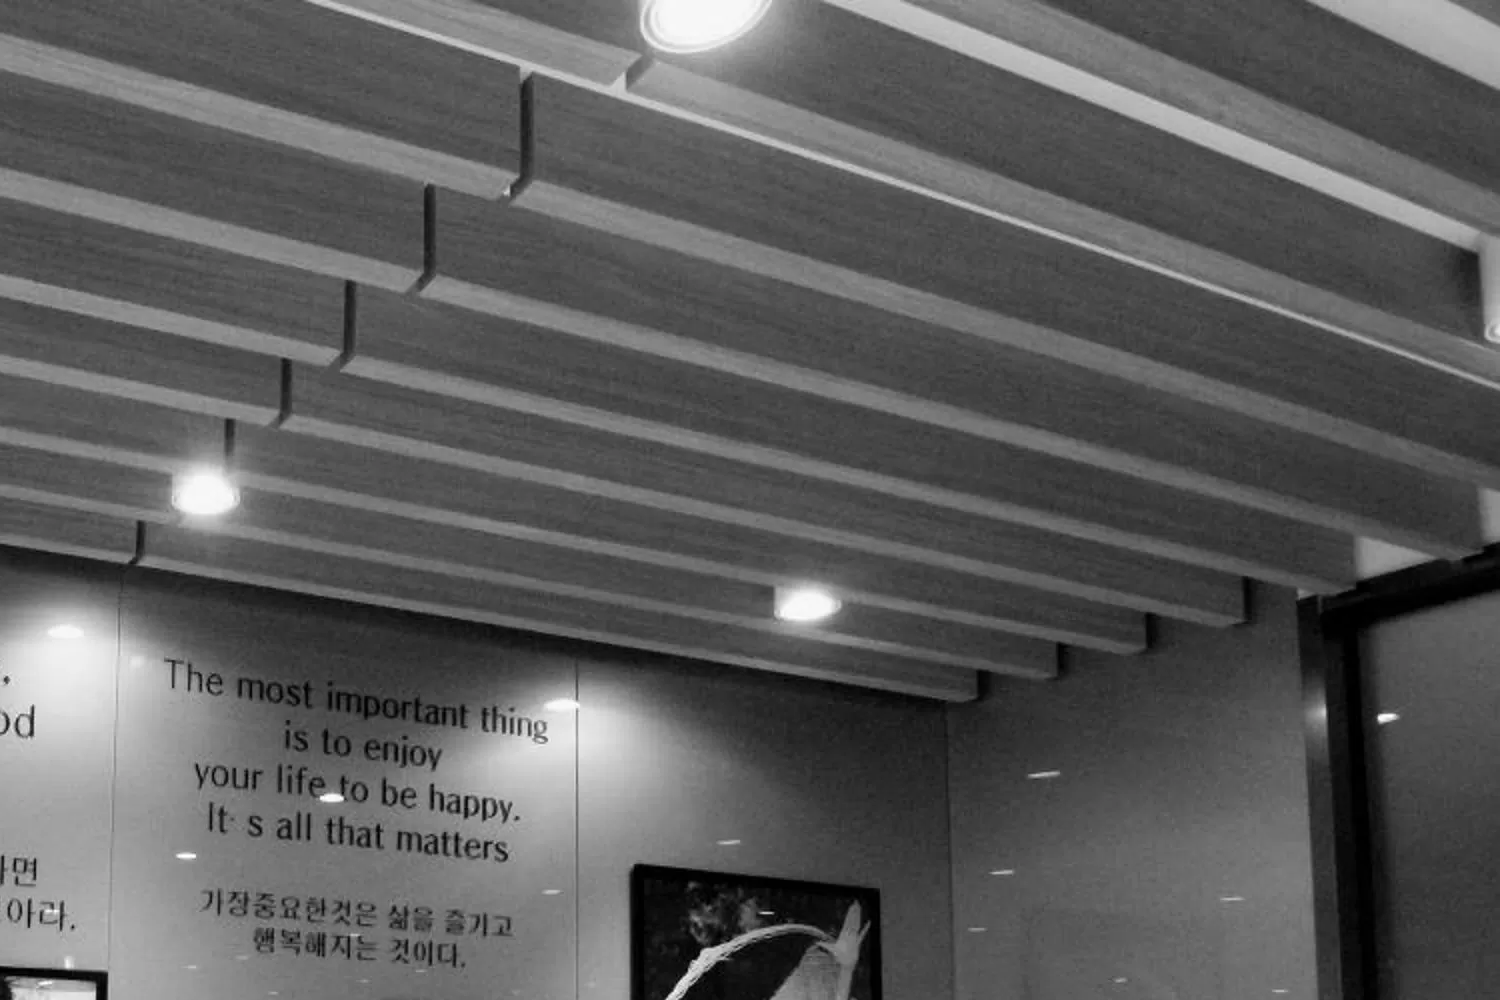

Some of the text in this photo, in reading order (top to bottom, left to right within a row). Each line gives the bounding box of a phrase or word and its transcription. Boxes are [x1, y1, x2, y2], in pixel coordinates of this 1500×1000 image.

[163, 657, 550, 746] The most important thing
[284, 719, 443, 773] is to enjoy
[194, 761, 522, 825] your life to be happy.
[275, 810, 313, 843] all
[326, 815, 386, 851] that
[395, 829, 509, 865] matters
[252, 926, 467, 970] 행복해지는 것이다.
[387, 904, 435, 934] 삶을
[444, 908, 514, 940] 즐기고
